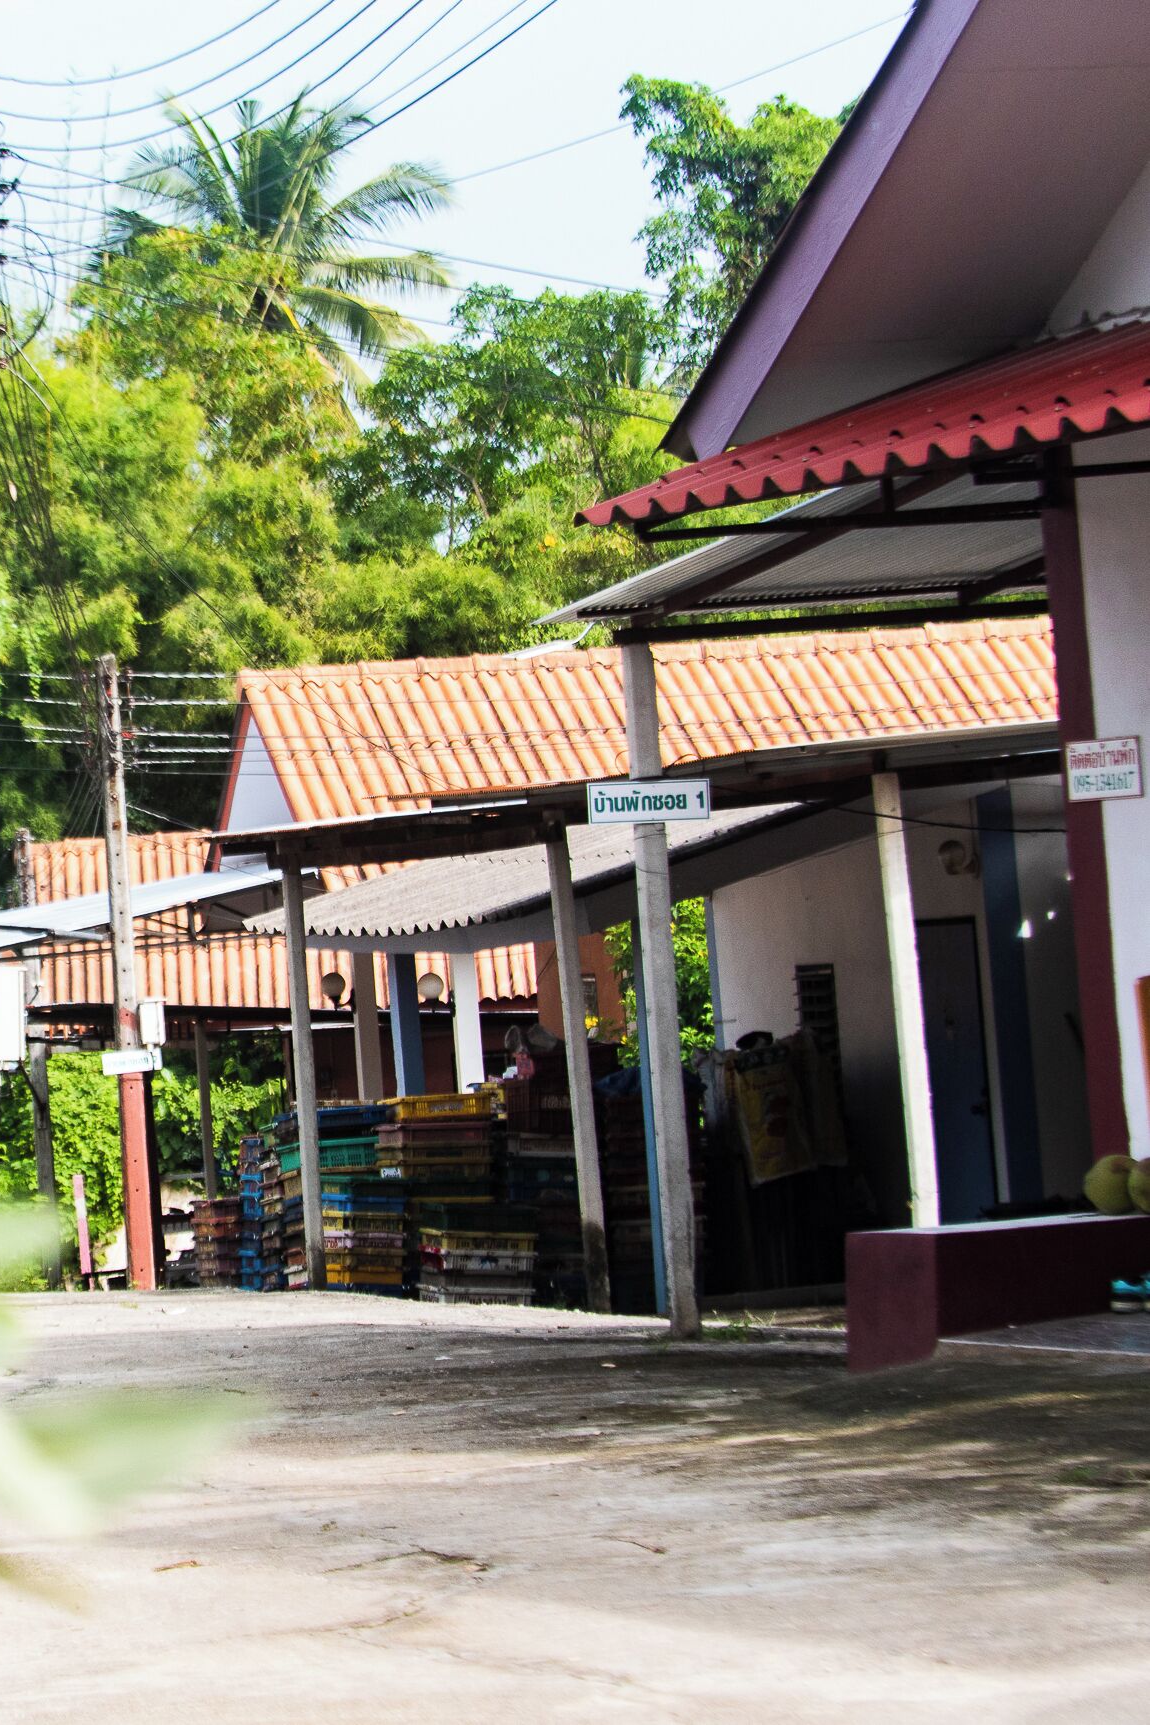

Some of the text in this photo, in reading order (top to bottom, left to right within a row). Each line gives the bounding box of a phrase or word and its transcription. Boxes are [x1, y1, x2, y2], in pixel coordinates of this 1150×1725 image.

[593, 790, 705, 813] บ้านพักซอย 1
